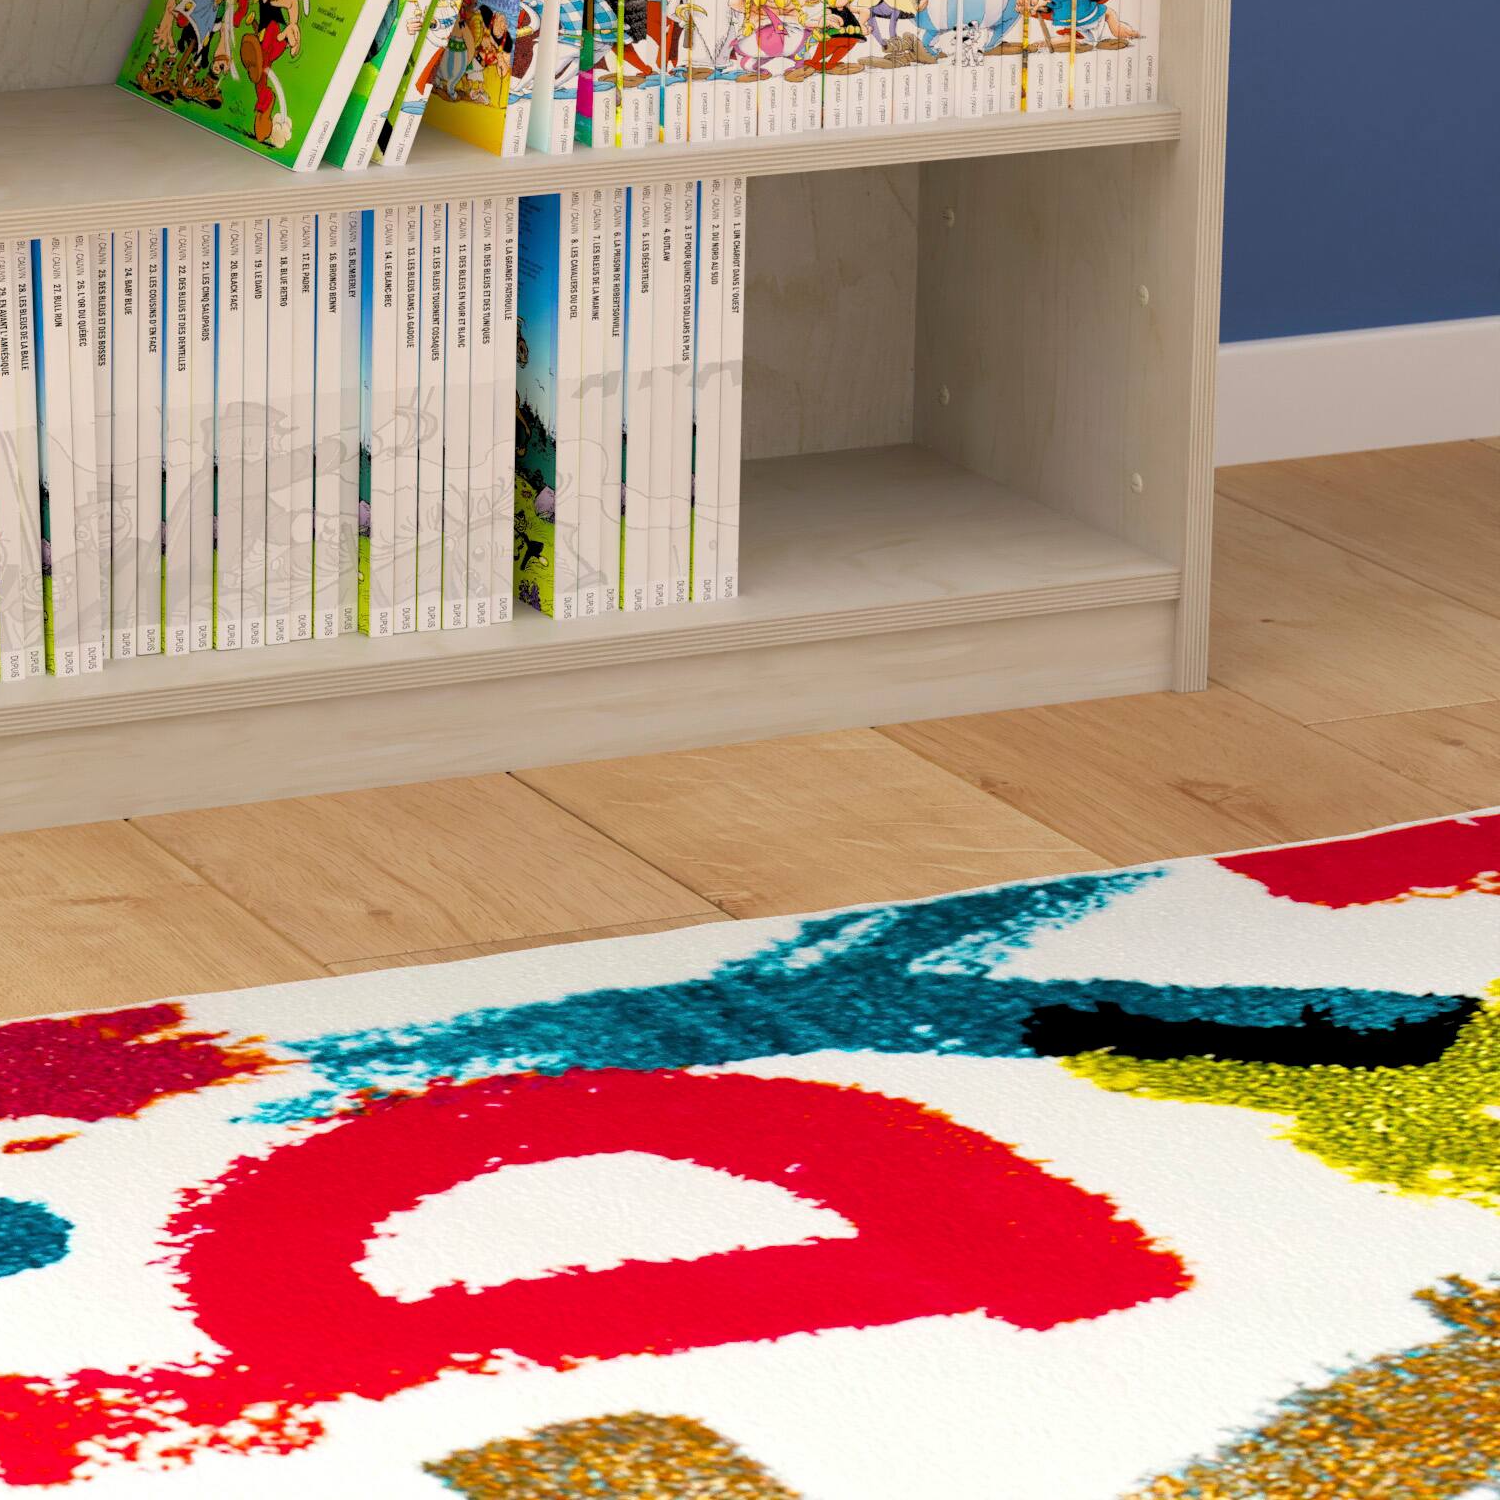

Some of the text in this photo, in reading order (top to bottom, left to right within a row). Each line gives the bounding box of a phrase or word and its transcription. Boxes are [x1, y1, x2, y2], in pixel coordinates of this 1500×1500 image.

[641, 239, 650, 252] LES
[711, 231, 720, 242] DU
[505, 246, 513, 255] LA
[663, 235, 671, 262] OUTLAW
[711, 242, 720, 261] NORD
[505, 255, 513, 282] GRANDE
[710, 261, 719, 271] AU
[230, 272, 239, 294] BLACK
[279, 267, 288, 285] BLUE
[328, 263, 338, 291] BRONCO
[710, 271, 719, 285] SUD
[124, 279, 133, 297] BABY
[279, 286, 288, 307] RETRO
[53, 295, 62, 313] BULL
[124, 297, 133, 316] BLUE
[229, 294, 238, 312] FACE
[328, 291, 337, 314] BENNY
[504, 282, 513, 321] PATROUILLE
[54, 312, 63, 328] RUN
